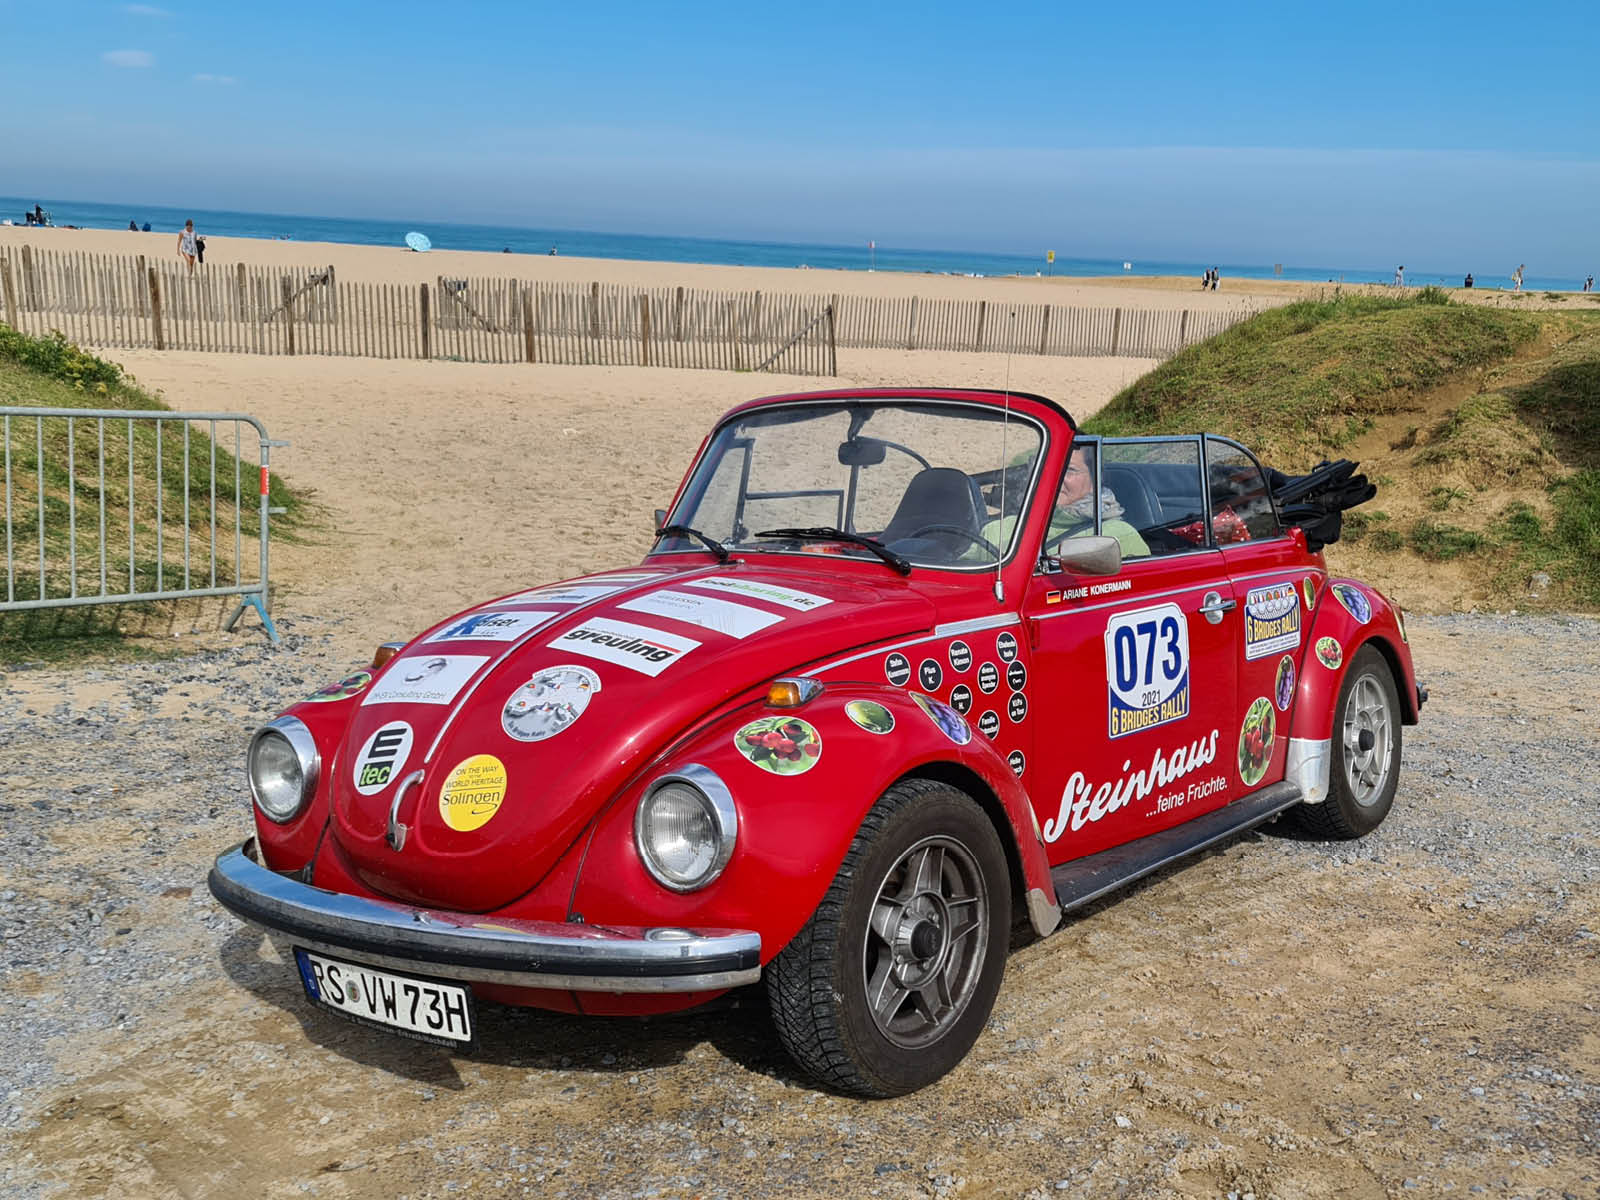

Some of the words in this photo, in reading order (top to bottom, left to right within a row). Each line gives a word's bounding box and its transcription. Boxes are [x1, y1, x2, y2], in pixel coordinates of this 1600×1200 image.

[1063, 587, 1088, 600] ARIANE
[1090, 580, 1131, 596] KONERMANN
[1248, 616, 1253, 643] 6
[1254, 620, 1281, 641] BRIDGES
[1282, 607, 1298, 633] RALLY
[564, 629, 674, 662] greuling
[1114, 616, 1181, 692] 073
[1112, 707, 1119, 735] 6
[1121, 707, 1159, 733] BRIDGES
[1161, 687, 1187, 720] RALLY
[1142, 689, 1161, 706] 2021
[368, 728, 408, 759] E
[360, 764, 390, 785] tec
[446, 780, 470, 788] WORLD
[472, 777, 503, 786] HERITAGE
[482, 765, 498, 773] WAY
[442, 791, 500, 808] Solingen
[1043, 729, 1219, 843] Steinhaus
[1187, 776, 1228, 803] Früchte.
[310, 960, 345, 1005] RS
[361, 973, 397, 1020] VW
[403, 984, 468, 1035] 73H
